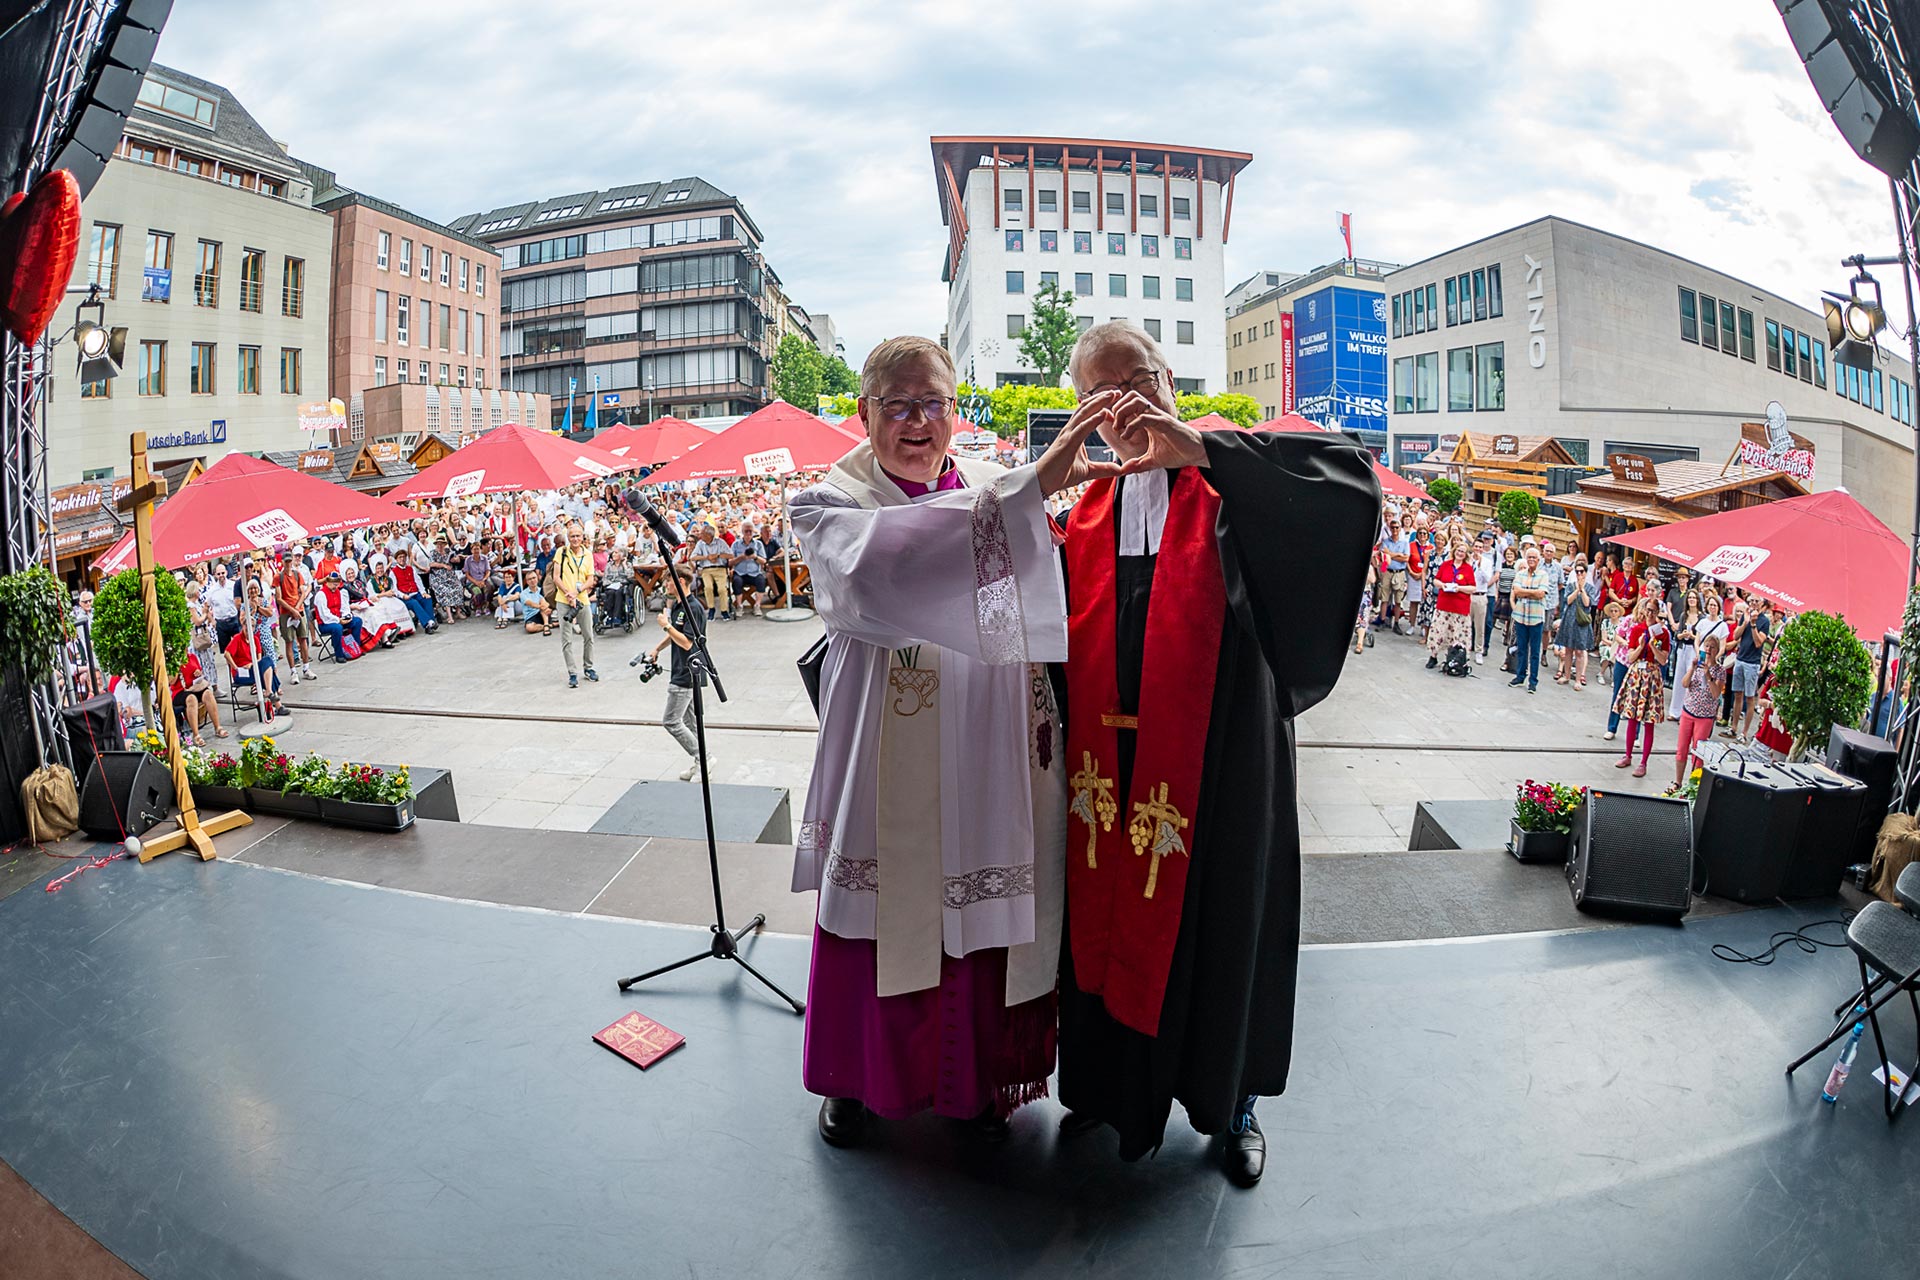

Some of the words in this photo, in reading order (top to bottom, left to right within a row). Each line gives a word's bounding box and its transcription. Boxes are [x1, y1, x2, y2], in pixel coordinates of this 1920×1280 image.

[1524, 254, 1546, 369] ONLY
[1284, 339, 1292, 366] HESSEN
[1347, 342, 1359, 352] IM
[1284, 367, 1292, 413] TREFFPUNKT
[1298, 396, 1330, 414] HESSEN
[184, 430, 208, 445] Bank
[304, 455, 329, 468] Weine
[1616, 456, 1629, 466] Bier
[1630, 460, 1644, 468] vom
[1744, 443, 1809, 476] Dorfschänke
[1625, 467, 1643, 480] Fass
[51, 489, 100, 513] Cocktails
[315, 522, 343, 532] reiner
[344, 517, 370, 526] Natur
[184, 552, 201, 562] Der
[203, 542, 241, 556] Genuss
[1653, 544, 1668, 552] Der
[1667, 549, 1694, 561] Genuss
[1749, 581, 1778, 595] reiner
[1776, 592, 1804, 606] Natur
